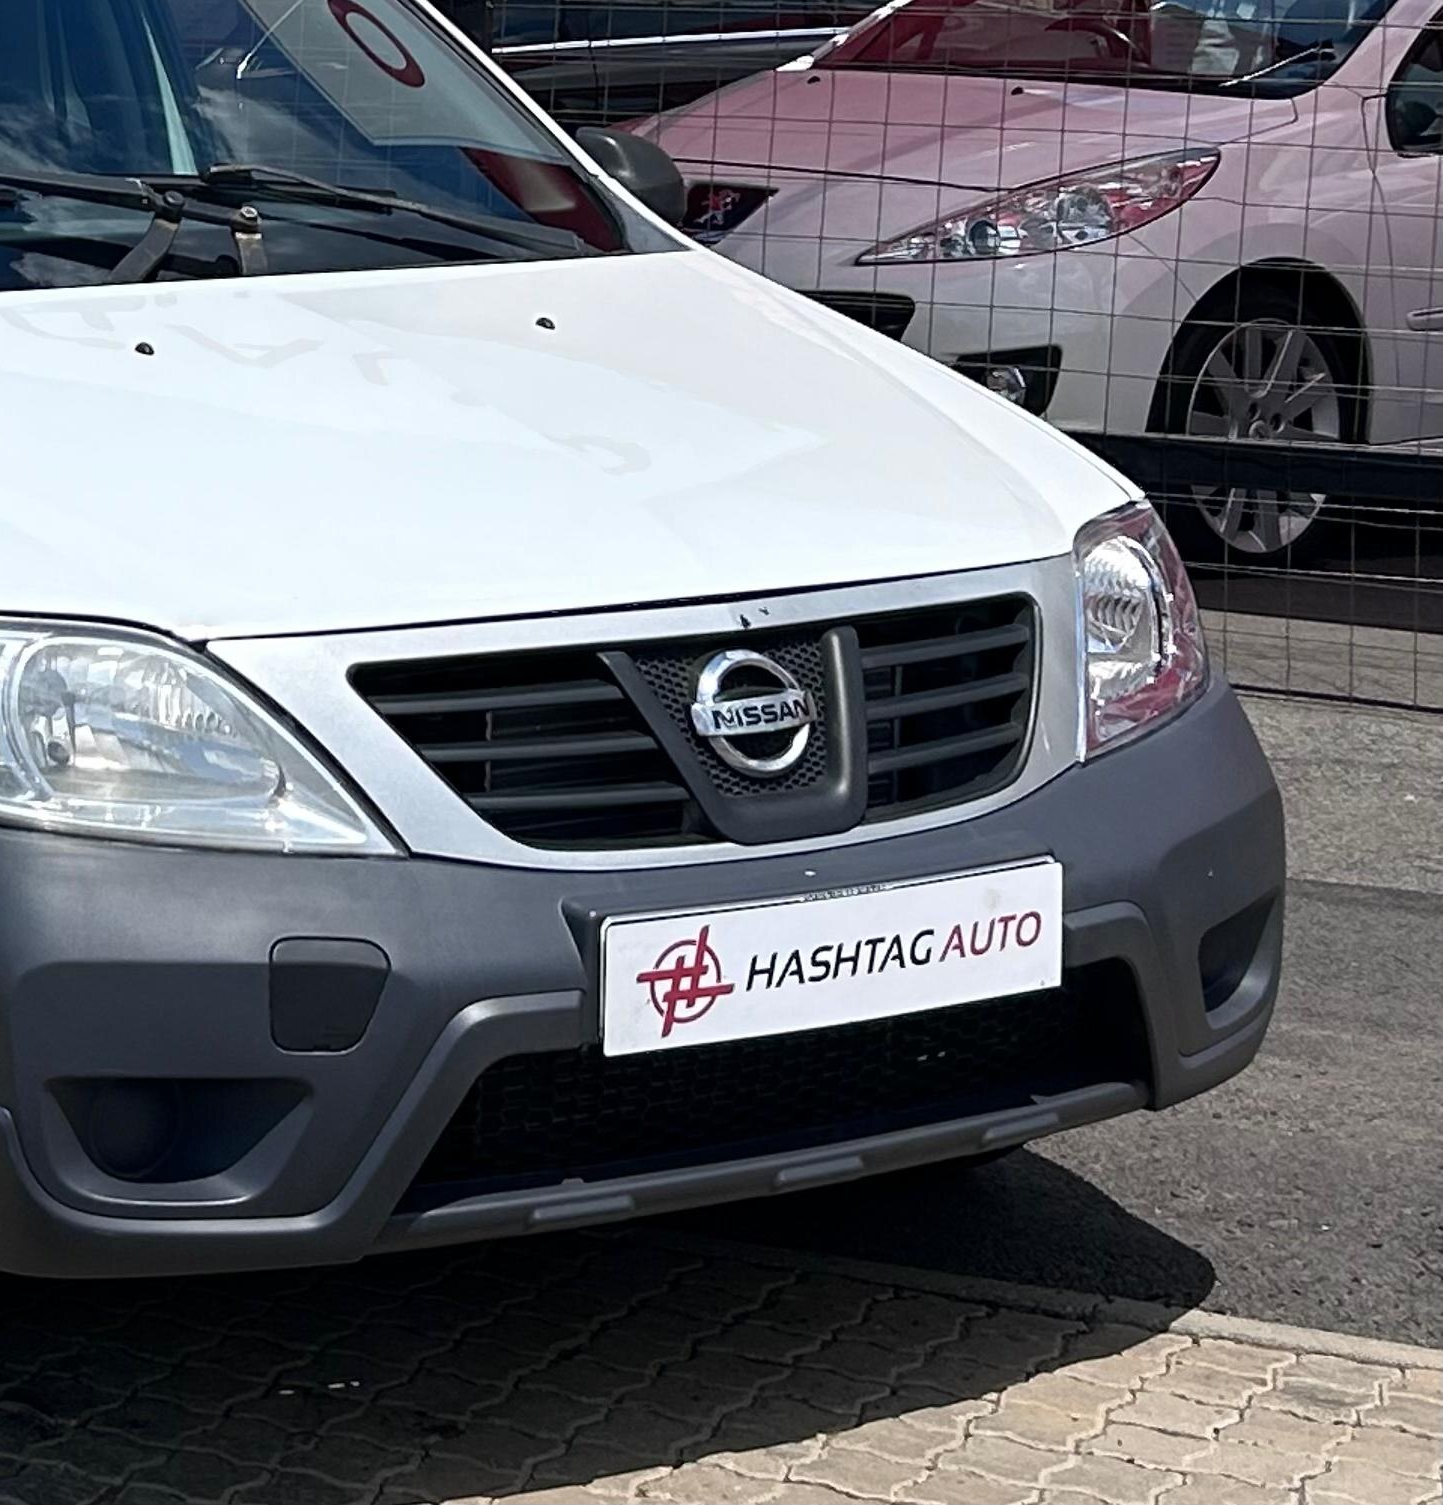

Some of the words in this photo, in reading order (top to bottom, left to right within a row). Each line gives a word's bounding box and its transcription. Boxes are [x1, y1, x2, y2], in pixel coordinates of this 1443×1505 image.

[711, 697, 810, 730] NISSAN
[746, 929, 935, 992] HASHTAG
[939, 911, 1042, 963] AUTO
